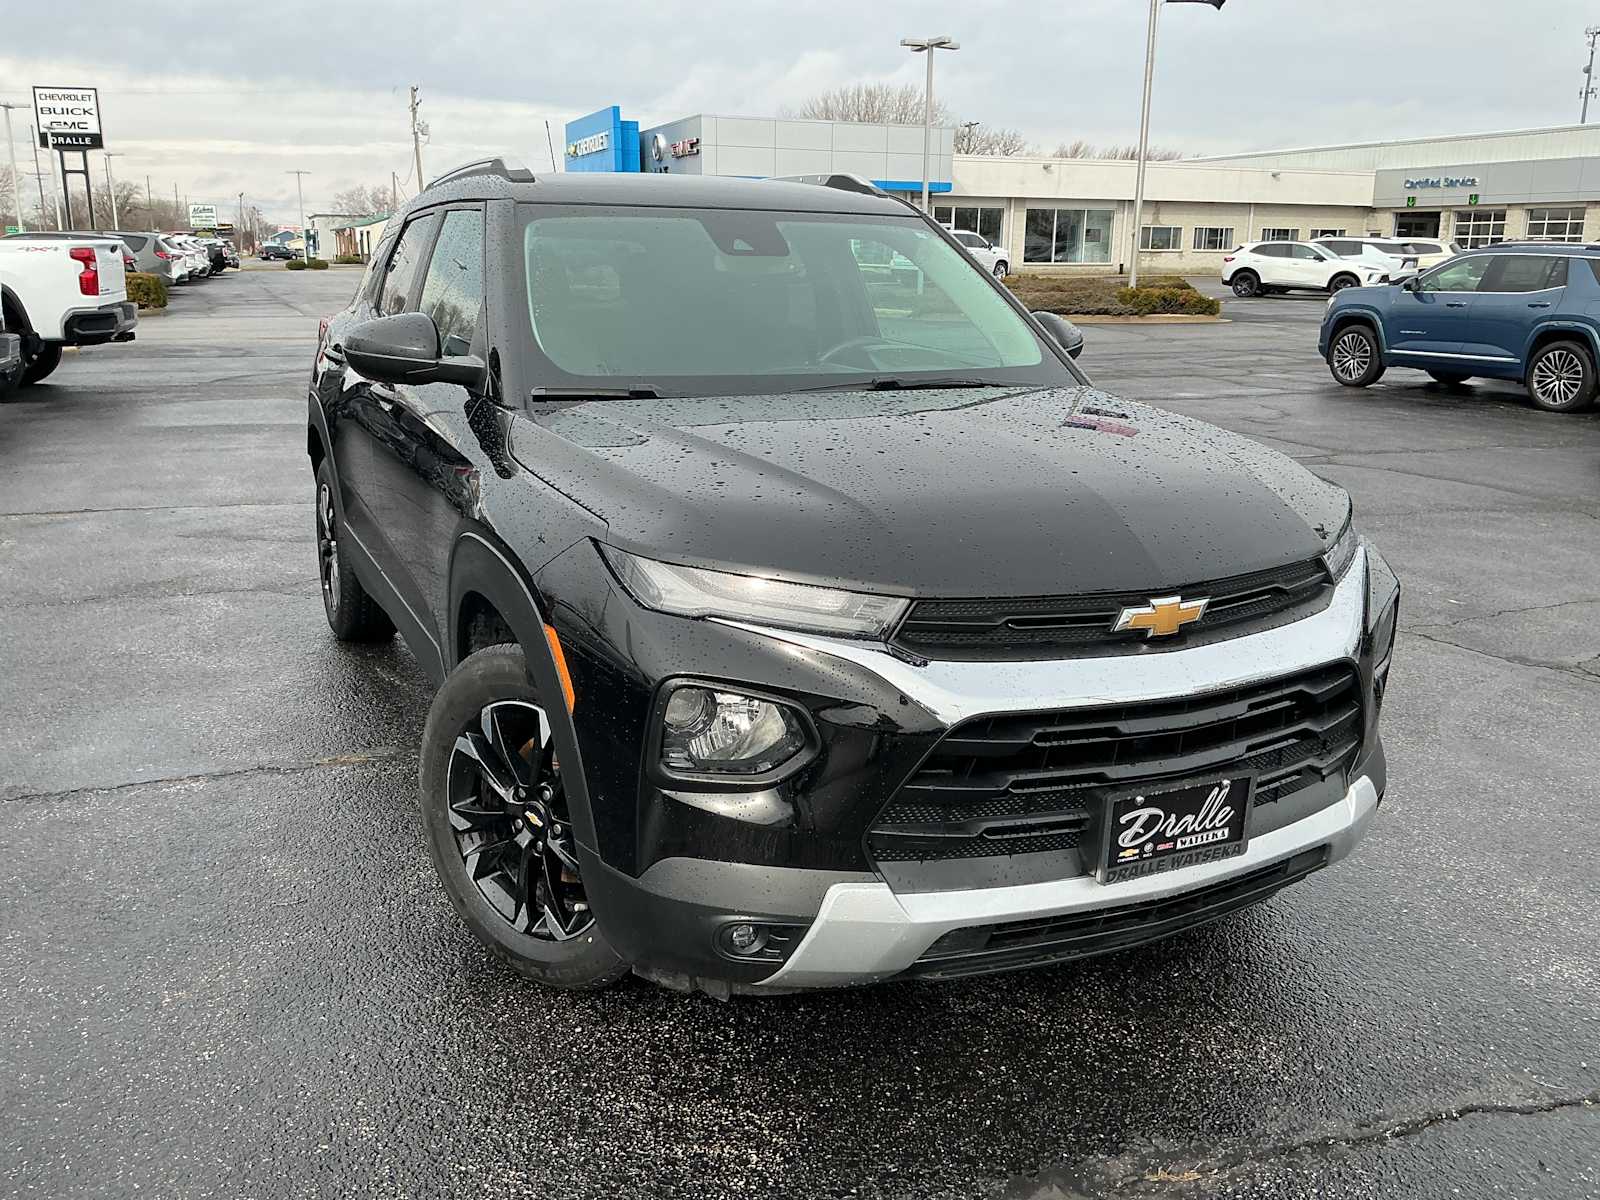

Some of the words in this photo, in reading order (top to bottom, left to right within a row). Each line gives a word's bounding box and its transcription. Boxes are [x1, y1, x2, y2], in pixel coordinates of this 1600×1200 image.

[38, 92, 92, 102] CHEVROLET
[40, 106, 94, 116] BUICK
[50, 121, 88, 130] GMC
[50, 136, 92, 145] DRALLE
[671, 138, 700, 158] GMC
[1404, 177, 1441, 189] Certified
[1443, 175, 1479, 187] Service
[1117, 785, 1236, 848] Dralle
[1179, 830, 1227, 848] WATSEKA
[1106, 857, 1167, 883] DRALLE
[1170, 844, 1241, 868] WATSEKA
